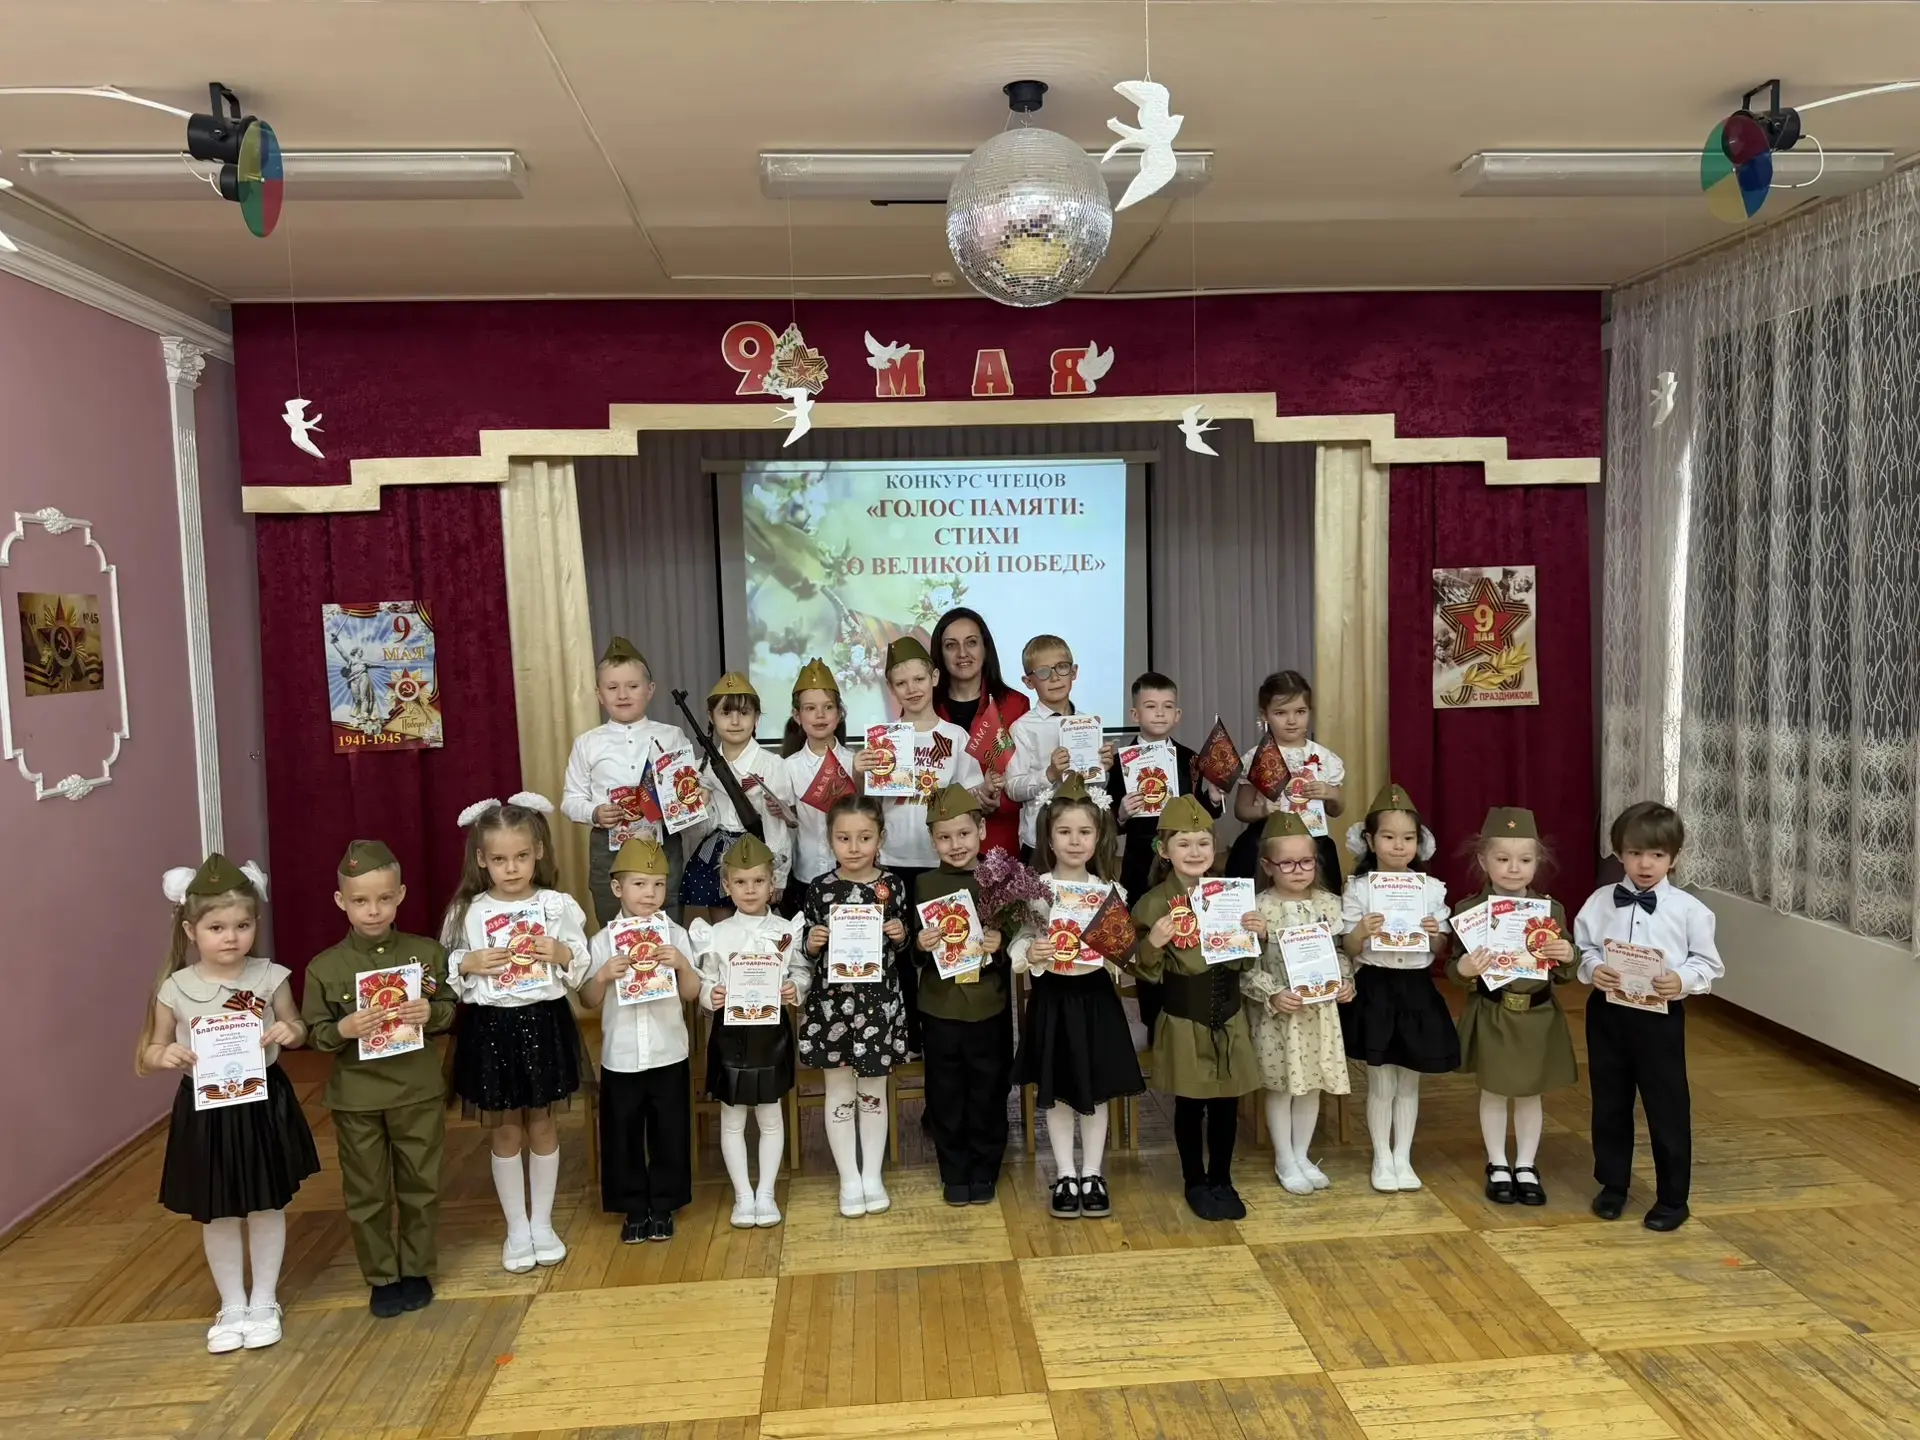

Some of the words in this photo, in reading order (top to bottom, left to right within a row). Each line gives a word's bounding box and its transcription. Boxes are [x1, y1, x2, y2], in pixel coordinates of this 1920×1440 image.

[722, 321, 778, 396] 9
[885, 473, 982, 490] КОНКУРС
[986, 472, 1066, 490] ЧТЕЦОВ
[866, 498, 964, 518] «ГОЛОС
[970, 497, 1084, 516] ПАМЯТИ:
[934, 526, 1019, 545] СТИХИ
[847, 556, 865, 576] О
[872, 551, 992, 576] ВЕЛИКОЙ
[997, 553, 1106, 575] ПОБЕДЕ»
[1473, 604, 1495, 632] 9
[393, 615, 411, 643] 9
[382, 646, 425, 661] МАЯ
[1480, 691, 1533, 701] ПРАЗДНИКОМ!
[338, 733, 402, 747] 1941-1945
[196, 1022, 259, 1036] Благодарность
